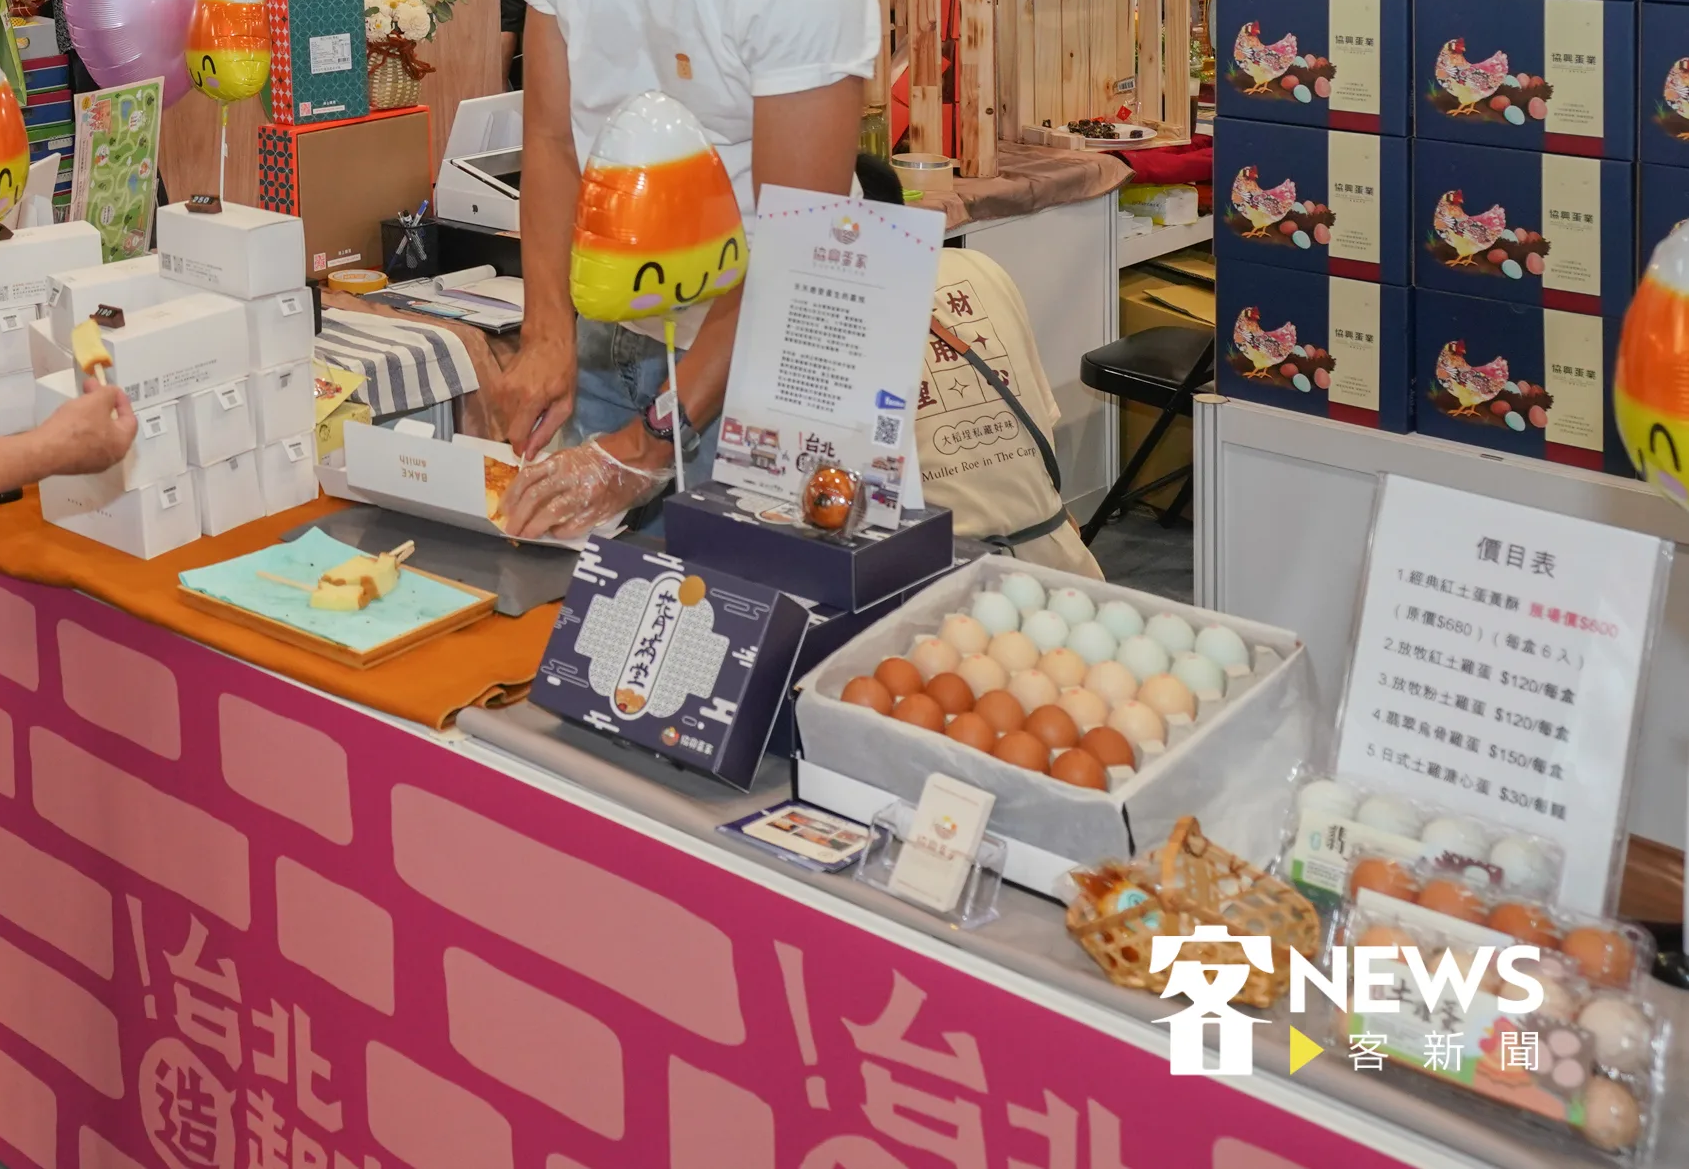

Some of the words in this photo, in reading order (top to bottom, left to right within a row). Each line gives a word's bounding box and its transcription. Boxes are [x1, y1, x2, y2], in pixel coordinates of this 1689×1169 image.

[1334, 34, 1375, 48] 協興蛋業
[1551, 52, 1598, 67] 協興蛋業
[1334, 182, 1375, 197] 協興蛋業
[1548, 208, 1595, 224] 協興蛋業
[946, 289, 974, 317] 材
[1334, 328, 1375, 345] 協興蛋業
[1550, 363, 1598, 381] 協興蛋業
[921, 461, 959, 483] Mullet
[961, 457, 981, 473] Roe
[983, 456, 993, 467] in
[994, 450, 1015, 465] The
[401, 467, 428, 483] BAKE
[1476, 535, 1557, 579] 價目表
